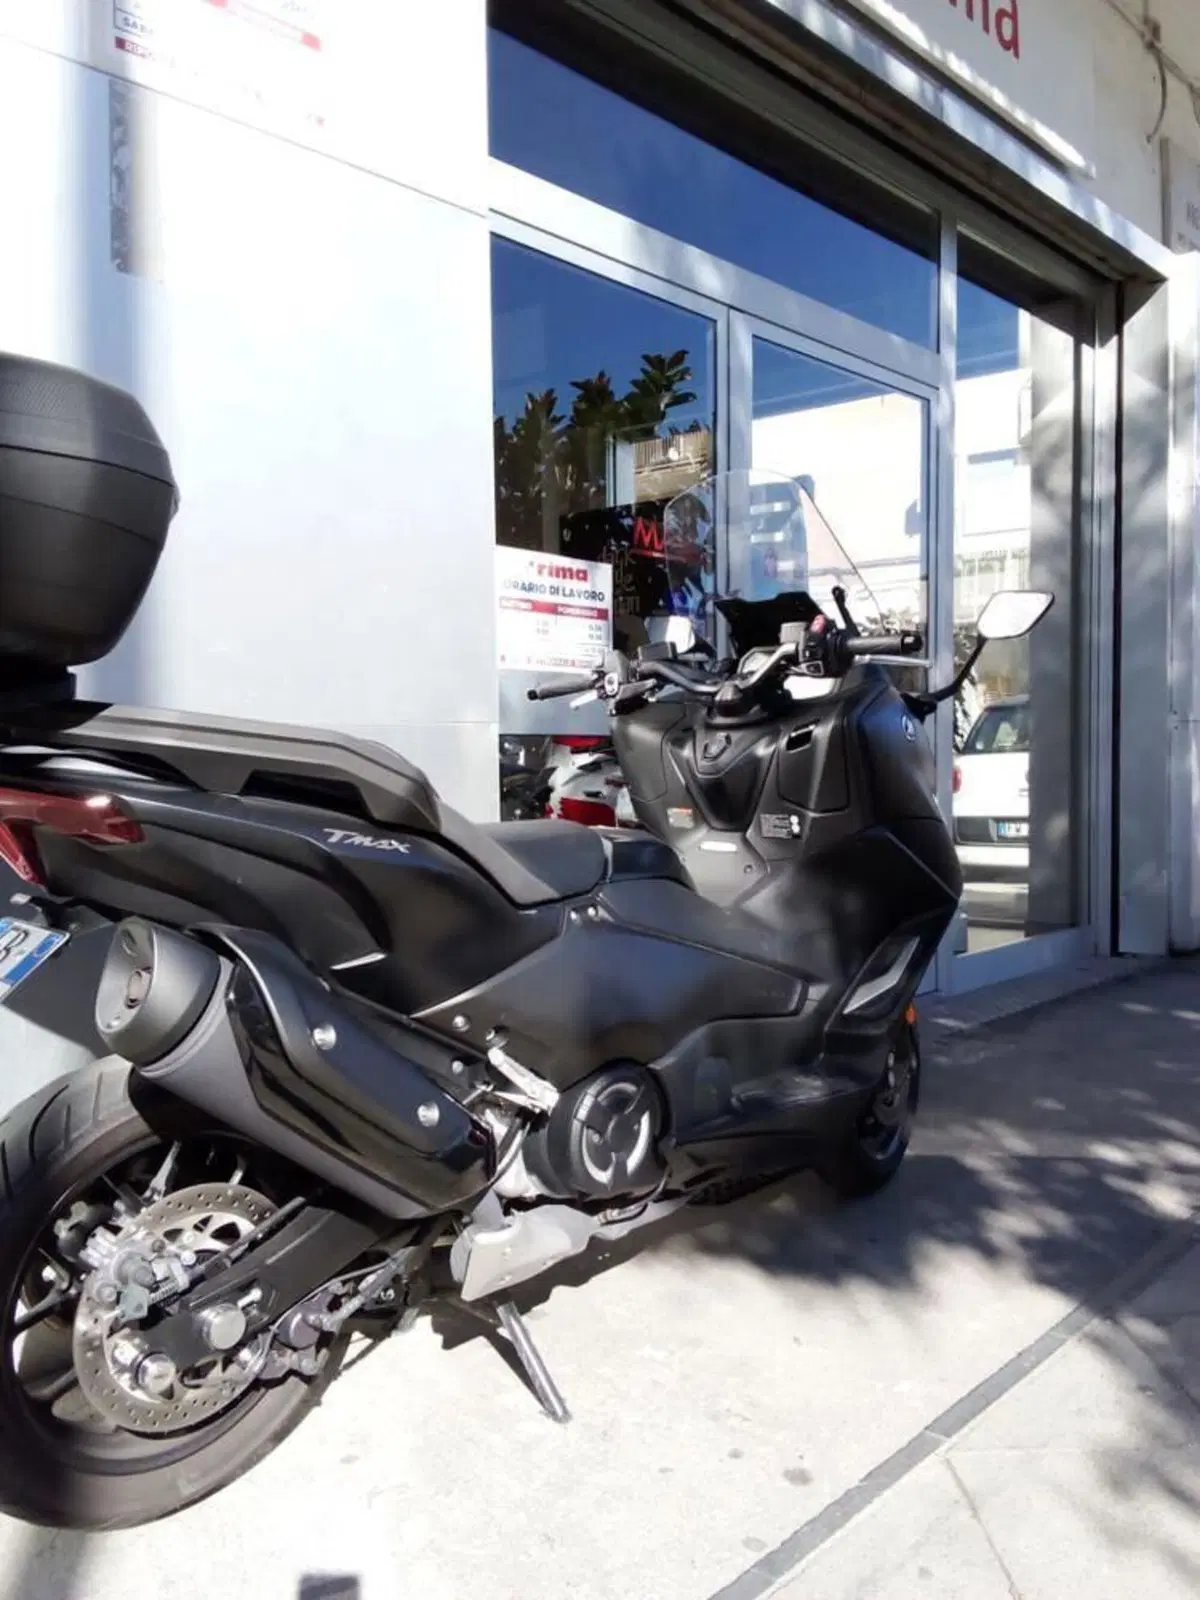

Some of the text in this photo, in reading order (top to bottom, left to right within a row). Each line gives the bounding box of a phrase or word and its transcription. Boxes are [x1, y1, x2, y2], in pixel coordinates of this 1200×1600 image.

[503, 579, 605, 603] ORARIO DI LAVORO
